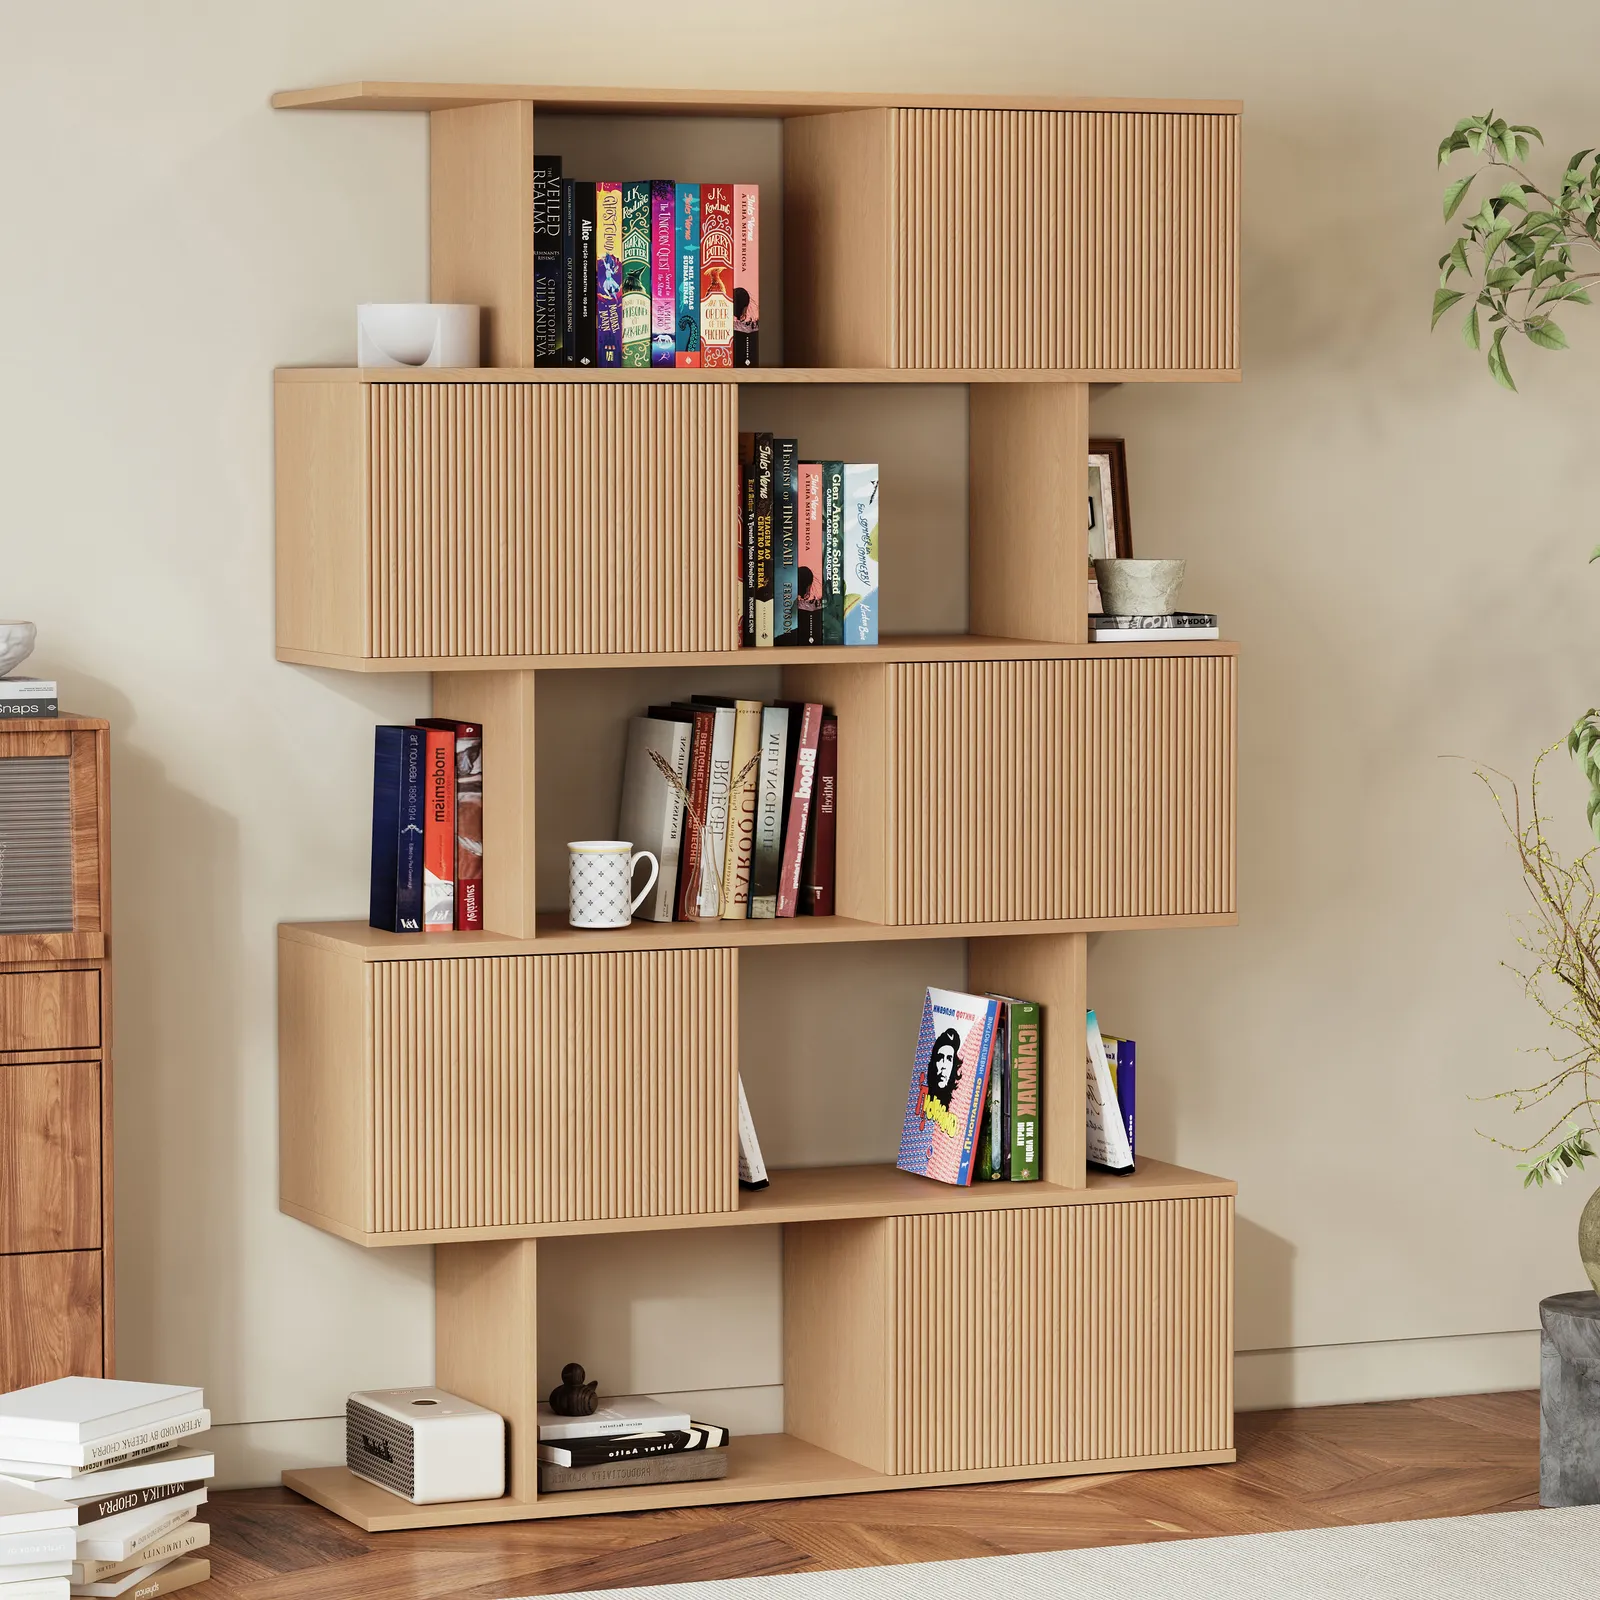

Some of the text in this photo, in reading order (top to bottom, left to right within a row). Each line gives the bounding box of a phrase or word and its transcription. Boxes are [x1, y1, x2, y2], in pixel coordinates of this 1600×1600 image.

[534, 170, 546, 234] REALMS
[546, 177, 560, 236] VEILED
[660, 202, 668, 212] The
[747, 194, 756, 216] Jules
[582, 219, 592, 241] Alice
[624, 234, 646, 250] HARRY
[624, 248, 647, 258] POTTER
[706, 234, 729, 250] HARRY
[706, 246, 730, 260] POTTER
[656, 248, 670, 271] QUEST
[688, 256, 694, 264] 20
[567, 272, 573, 280] OF
[688, 281, 696, 310] LÉGUAS
[536, 276, 546, 358] VILLANUEVA
[547, 279, 556, 356] CHRISTOPHER
[664, 302, 672, 331] KAMILLA
[760, 445, 771, 499] Jules Verne
[782, 443, 793, 488] HENGIST
[811, 474, 820, 496] Jules
[832, 474, 841, 594] Cien Años de Soledad
[758, 550, 764, 561] DA
[764, 548, 770, 560] AO
[782, 582, 792, 634] FERGUSON
[860, 602, 871, 626] Kirsten
[0, 704, 39, 716] naps
[410, 734, 418, 746] art
[408, 748, 418, 783] nouveau
[400, 918, 419, 928] V&A
[92, 1418, 202, 1458] AFTERWORD BY DEEPAK CHOPRA
[98, 1481, 186, 1516] MALLIKA CHOPRA
[142, 1536, 196, 1561] ON IMMUNITY
[134, 1582, 160, 1598] spherical
